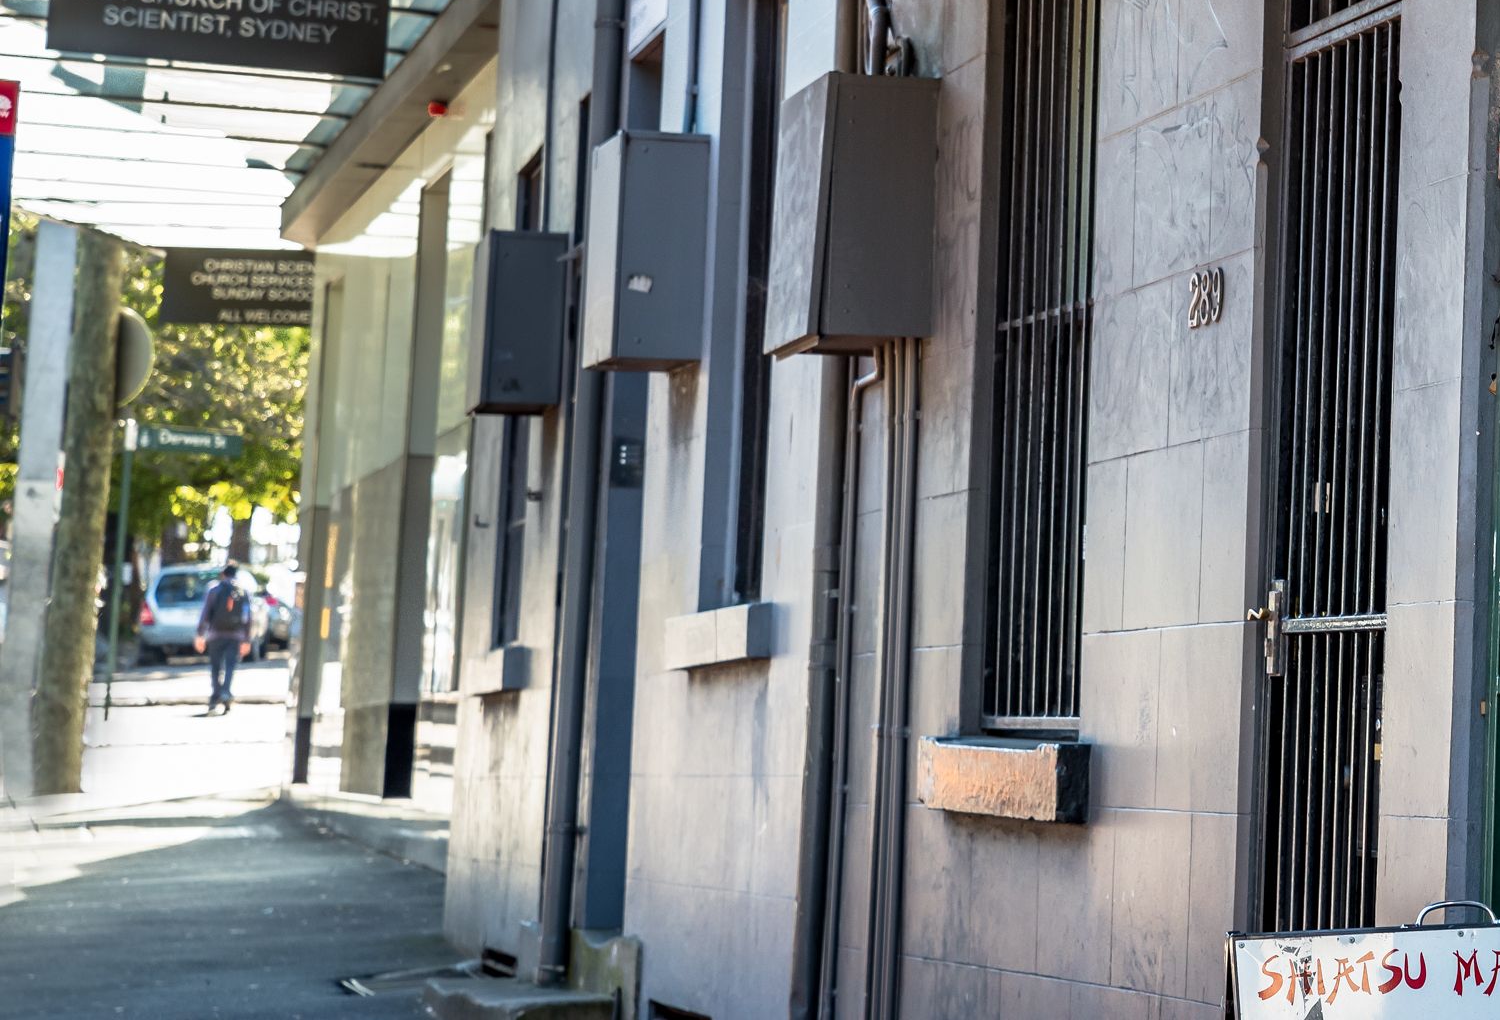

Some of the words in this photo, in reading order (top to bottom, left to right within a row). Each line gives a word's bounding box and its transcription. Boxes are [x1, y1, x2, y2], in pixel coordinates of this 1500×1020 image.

[104, 5, 233, 38] SCIENTIST,
[239, 17, 338, 45] SYDNEY
[203, 258, 275, 273] CHRISTIAN
[190, 271, 249, 286] CHURCH
[212, 286, 265, 300] SUNDAY
[1188, 267, 1224, 328] 289
[218, 309, 241, 323] ALL
[243, 309, 312, 324] WELCOME
[1258, 949, 1427, 1005] SHIATSU
